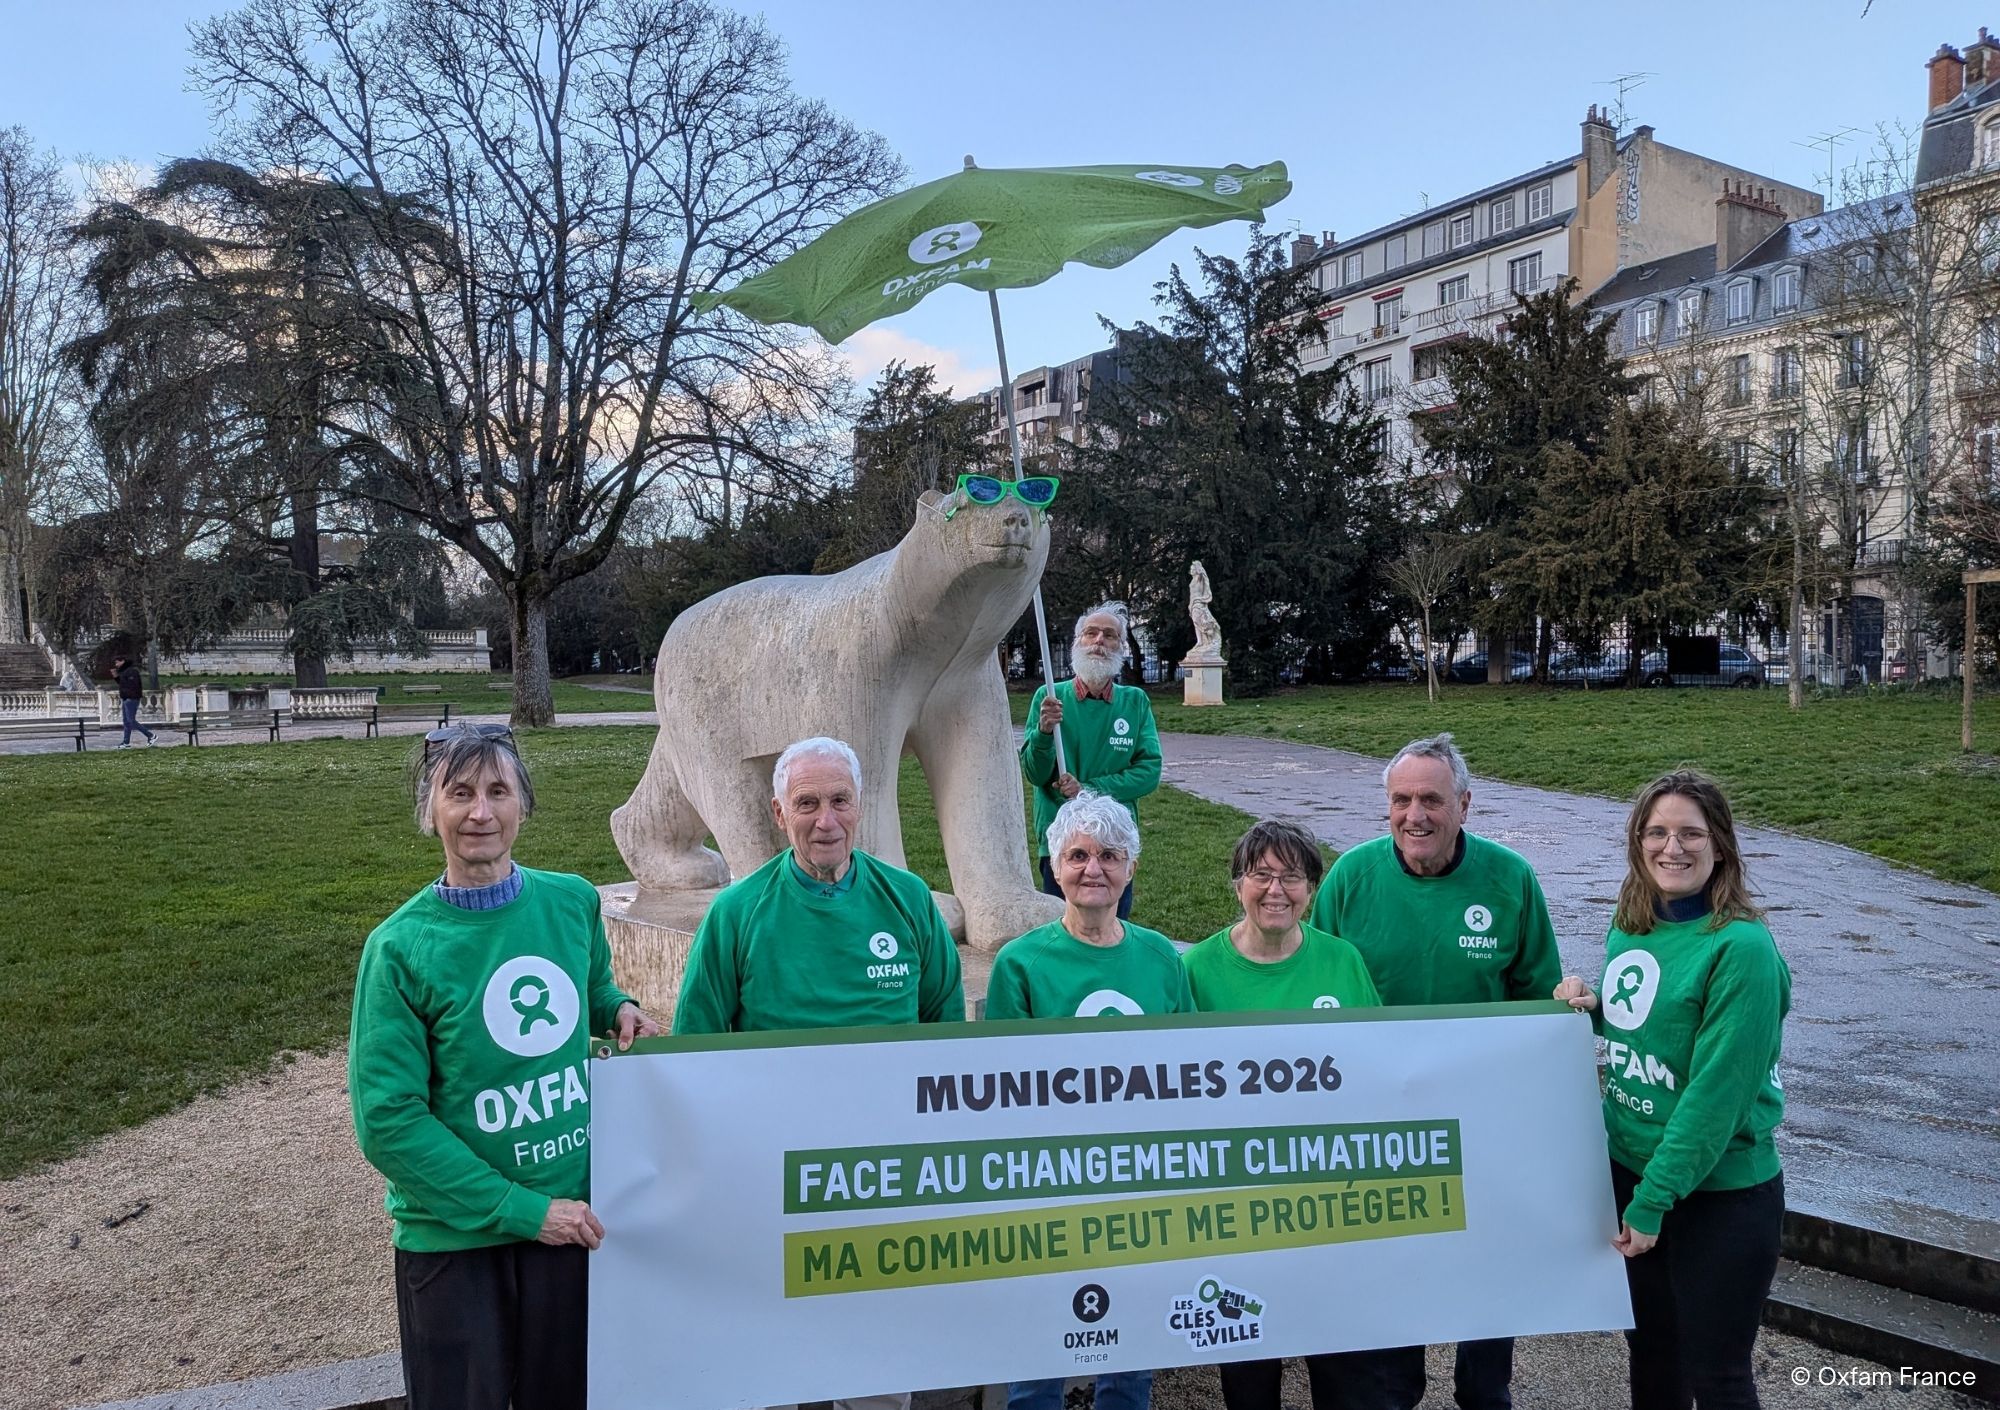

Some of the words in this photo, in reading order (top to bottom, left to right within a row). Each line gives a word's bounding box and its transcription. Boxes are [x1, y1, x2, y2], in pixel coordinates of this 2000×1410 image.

[882, 257, 991, 296] OXFAM
[1109, 736, 1134, 746] OXFAM
[1458, 935, 1498, 949] OXFAM
[1467, 950, 1493, 959] France
[866, 963, 910, 979] OXFAM
[877, 981, 904, 989] France
[1605, 1039, 1675, 1091] FAM
[916, 1059, 1227, 1114] MUNICIPALES
[1237, 1055, 1342, 1095] 2026
[474, 1058, 591, 1133] OXFA
[1605, 1077, 1654, 1115] France
[800, 1158, 902, 1203] FACE
[915, 1154, 967, 1195] AU
[981, 1140, 1232, 1191] CHANGEMENT
[1244, 1129, 1450, 1175] CLIMATIQUE
[803, 1242, 863, 1283] MA
[877, 1219, 1069, 1275] COMMUNE
[1081, 1208, 1173, 1254] PEUT
[1185, 1202, 1237, 1243] ME
[1249, 1179, 1430, 1237] PROTÉGER
[1440, 1181, 1451, 1216] !
[1174, 1300, 1194, 1311] LES
[1169, 1307, 1216, 1330] CLÉS
[1063, 1328, 1119, 1349] OXFAM
[1190, 1330, 1202, 1340] DE
[1196, 1338, 1208, 1348] LA
[1206, 1322, 1260, 1346] VILLE
[1074, 1352, 1108, 1364] France
